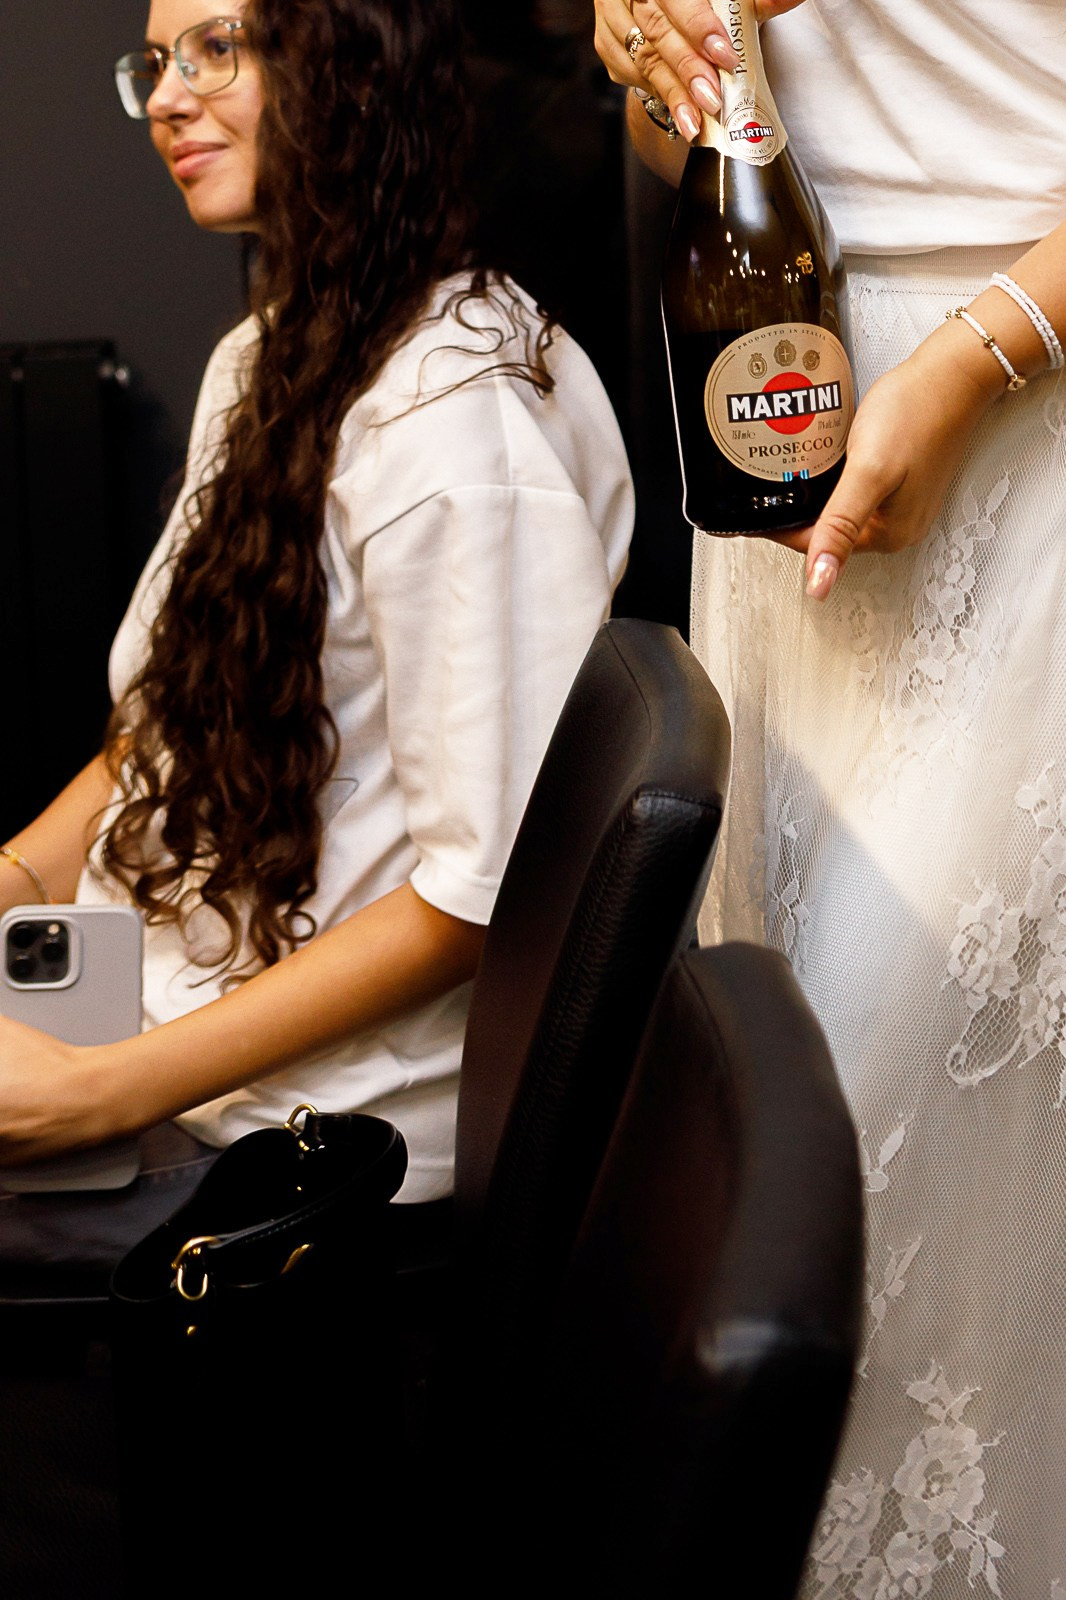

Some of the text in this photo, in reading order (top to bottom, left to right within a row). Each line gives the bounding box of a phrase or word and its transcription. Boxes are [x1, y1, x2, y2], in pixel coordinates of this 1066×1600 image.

[730, 127, 773, 142] MARTINI
[737, 329, 785, 350] PRODOTTO
[802, 329, 827, 341] ITALIA
[729, 383, 841, 421] MARTINI
[748, 436, 834, 458] PROSECCO
[782, 455, 809, 464] D.O.C.
